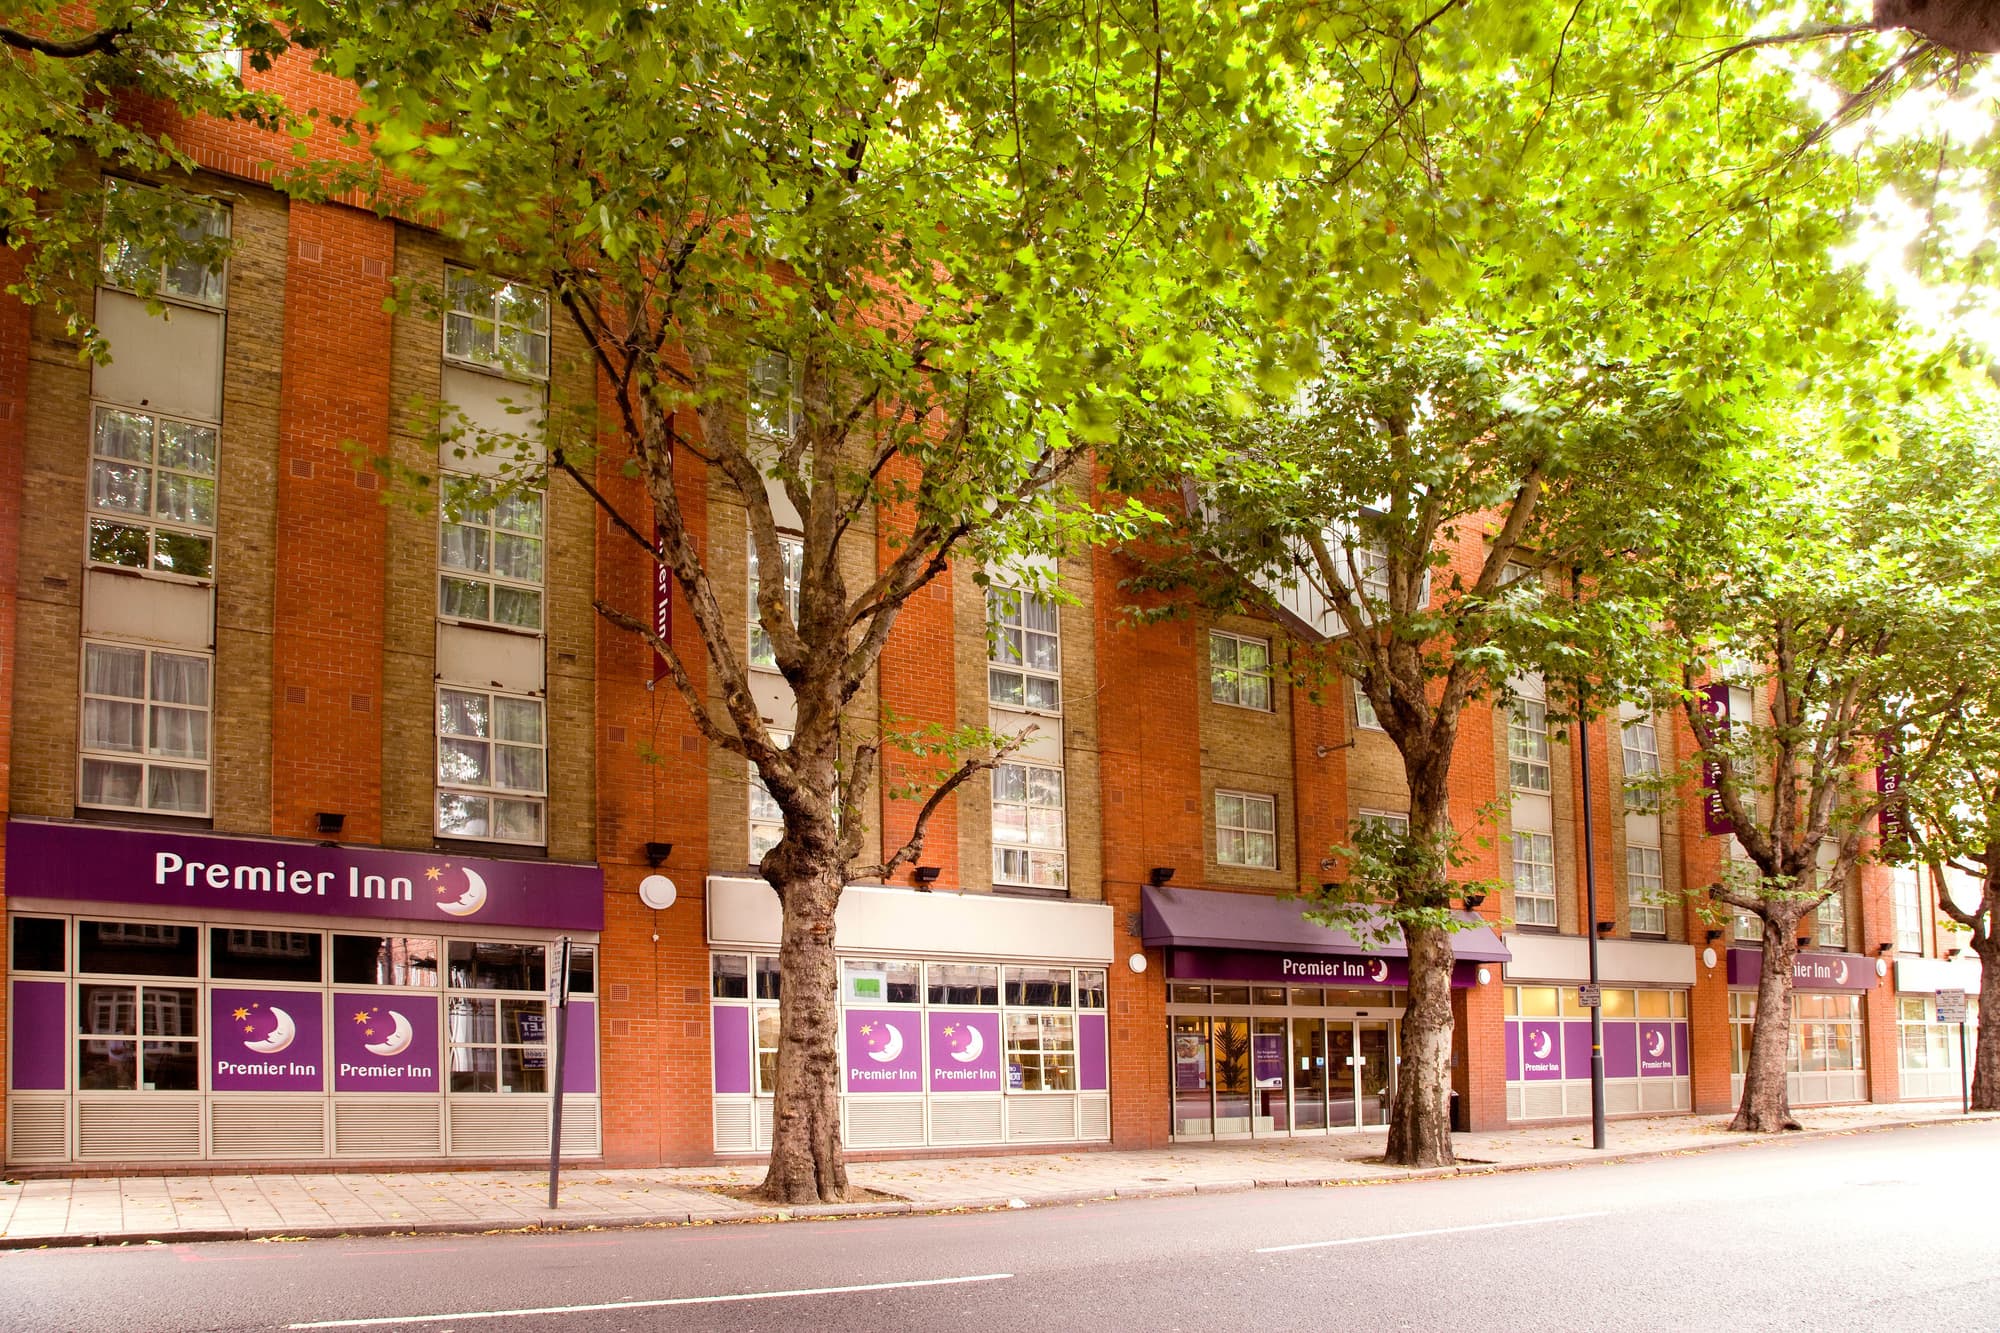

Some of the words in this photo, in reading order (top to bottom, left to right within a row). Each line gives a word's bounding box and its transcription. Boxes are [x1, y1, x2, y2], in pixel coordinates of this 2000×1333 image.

[659, 598, 669, 640] Inn
[155, 852, 335, 896] Premier
[349, 866, 413, 901] Inn
[1283, 959, 1341, 976] Premier
[1343, 961, 1365, 976] Inn
[1814, 962, 1831, 978] Inn
[218, 1061, 287, 1076] Premier
[289, 1062, 316, 1076] Inn
[340, 1063, 405, 1077] Premier
[407, 1064, 432, 1078] Inn
[851, 1068, 898, 1080] Premier
[899, 1068, 917, 1080] Inn
[934, 1068, 979, 1080] Premier
[979, 1068, 997, 1080] Inn
[1525, 1063, 1549, 1072] Premier
